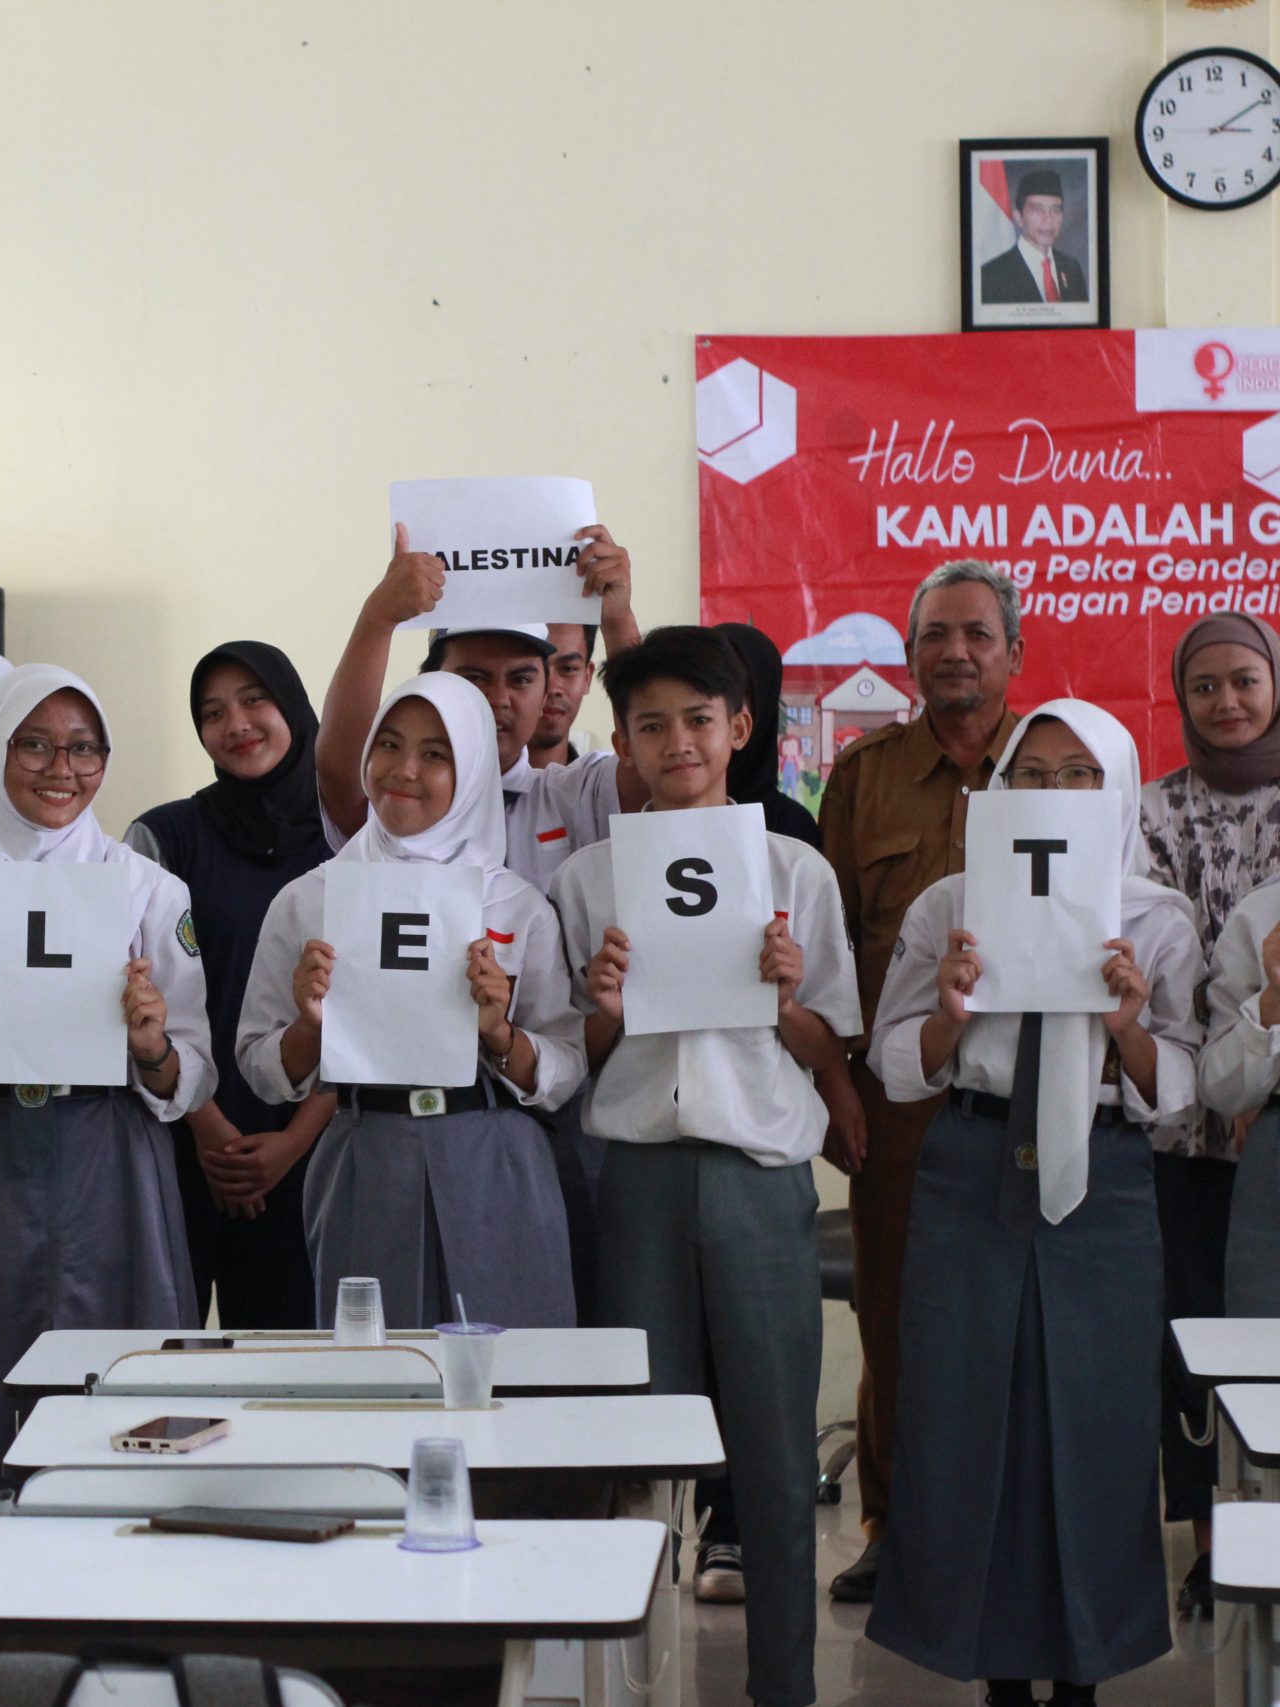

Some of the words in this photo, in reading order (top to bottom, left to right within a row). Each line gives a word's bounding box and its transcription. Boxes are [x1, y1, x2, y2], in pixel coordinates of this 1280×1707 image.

[1206, 66, 1223, 82] 12
[1240, 72, 1247, 88] 1
[1179, 76, 1193, 92] 11
[1260, 89, 1272, 105] 2
[1159, 99, 1176, 116] 10
[1152, 126, 1165, 142] 9
[1163, 153, 1174, 169] 8
[1262, 146, 1273, 163] 4
[1186, 172, 1196, 188] 7
[1215, 177, 1227, 193] 6
[1244, 169, 1254, 185] 5
[1239, 377, 1280, 392] INDO
[848, 420, 976, 487] Hallo
[877, 505, 1008, 548] KAMI
[1021, 503, 1234, 547] ADALAH
[434, 545, 581, 572] ALESTINA
[1046, 552, 1136, 582] Peka
[1020, 592, 1128, 622] ungan
[1140, 584, 1280, 615] Pendidi
[1013, 838, 1068, 897] T
[665, 857, 718, 918] S
[26, 910, 73, 969] L
[380, 912, 430, 972] E
